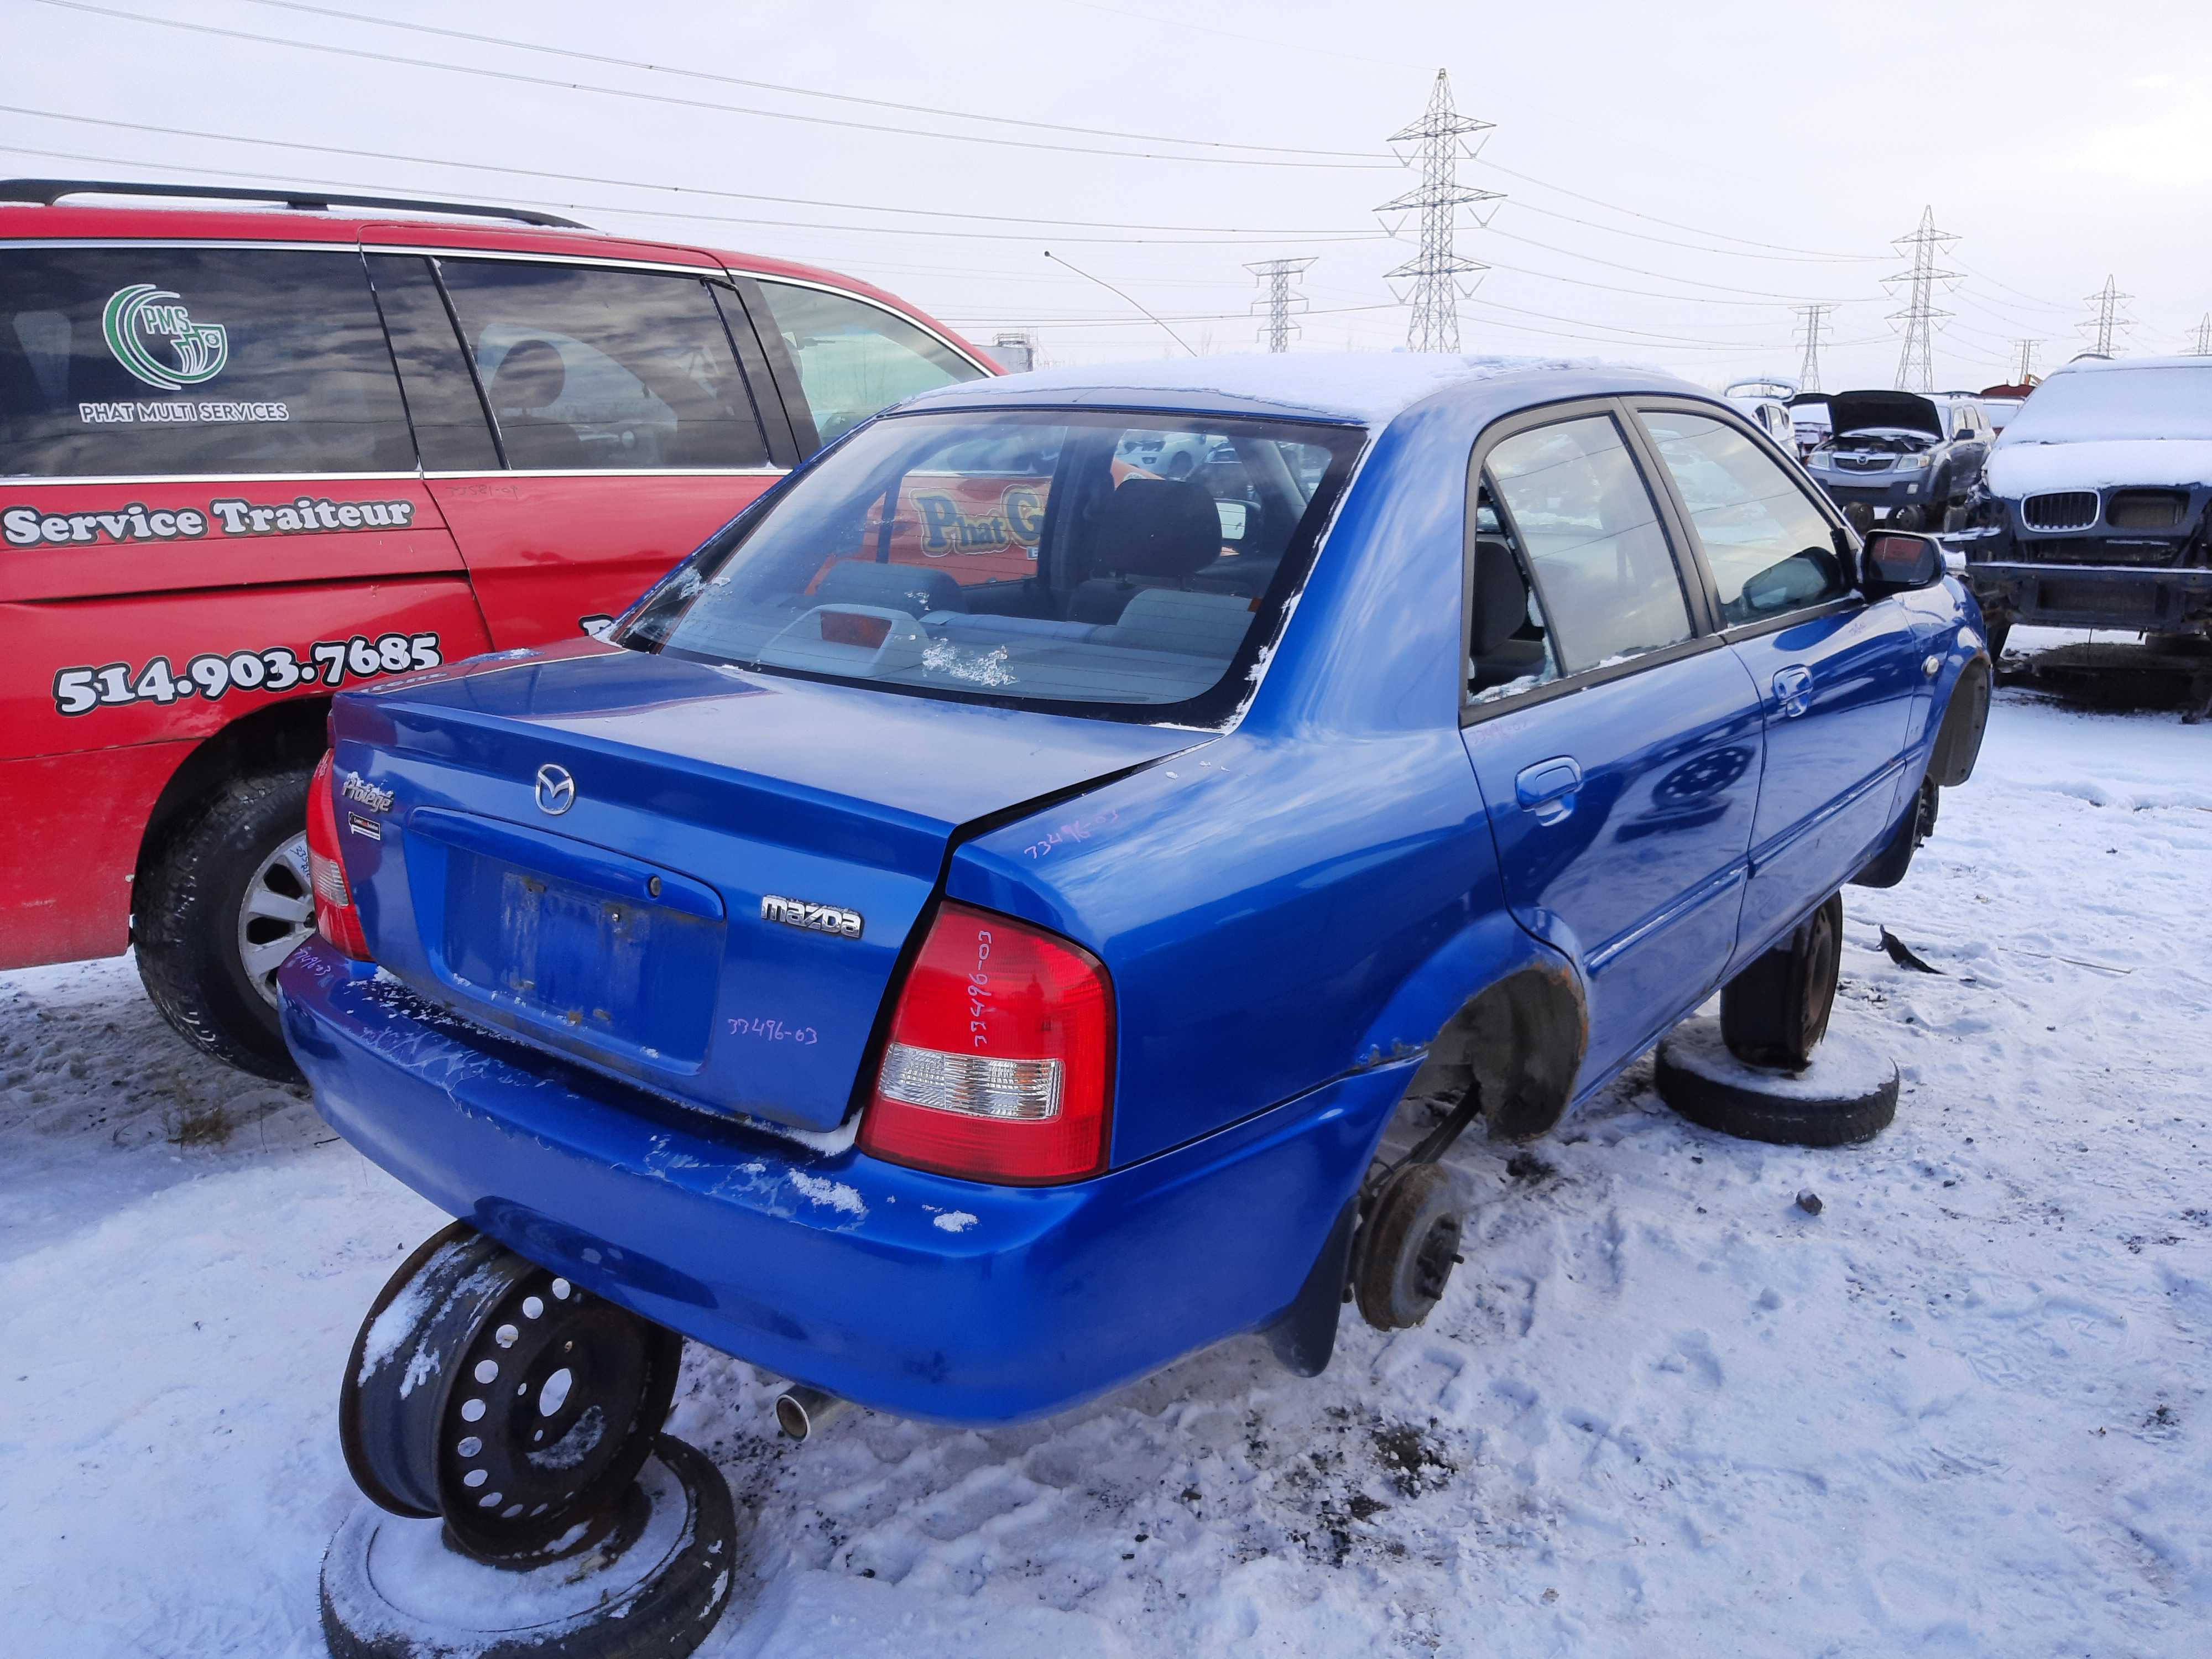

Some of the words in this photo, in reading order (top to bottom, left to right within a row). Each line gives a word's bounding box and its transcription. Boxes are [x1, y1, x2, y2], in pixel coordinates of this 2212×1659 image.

[139, 306, 191, 334] PMS
[79, 403, 134, 422] PHAT
[137, 403, 197, 422] MULTI
[200, 402, 289, 422] SERVICES
[3, 504, 205, 545] Service
[212, 499, 413, 535] Traiteur
[912, 492, 1009, 550] Phat
[56, 635, 441, 714] 514.903.7685
